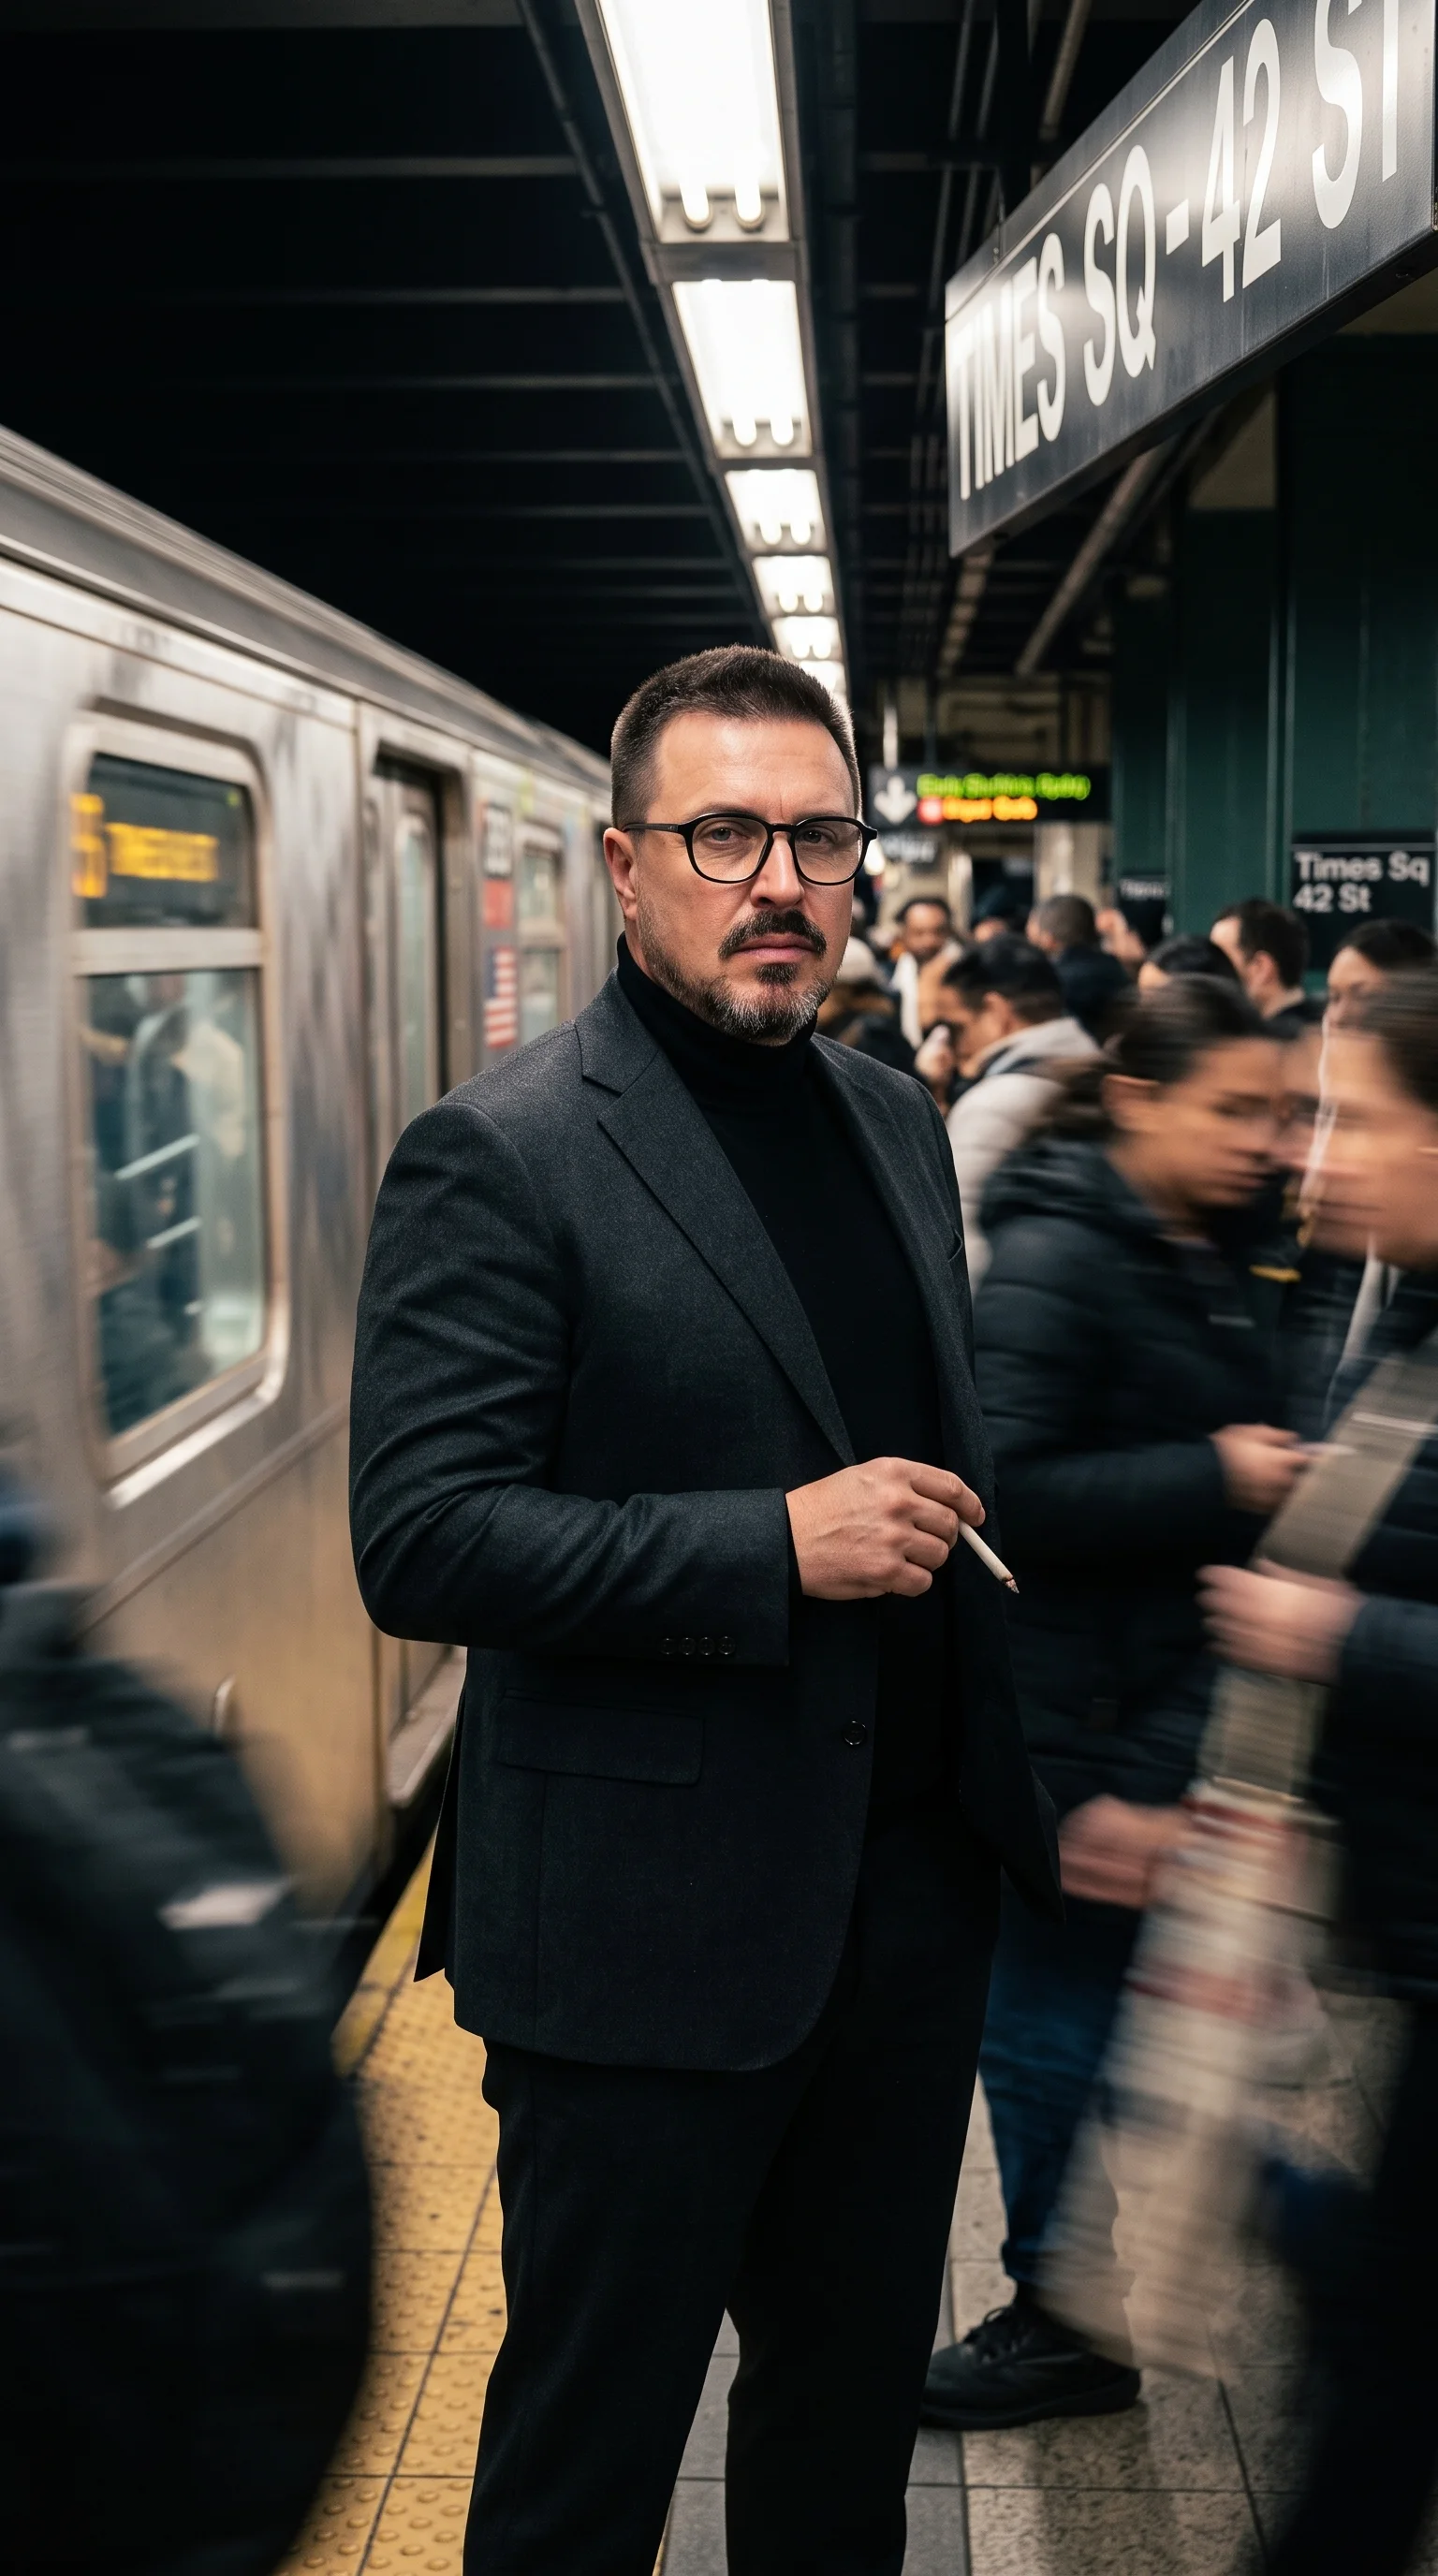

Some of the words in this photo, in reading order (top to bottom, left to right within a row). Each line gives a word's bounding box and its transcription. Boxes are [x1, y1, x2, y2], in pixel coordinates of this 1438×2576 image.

[951, 232, 1066, 501] TIMES
[1294, 851, 1383, 882] Times
[1387, 850, 1431, 887] Sq
[1293, 883, 1334, 914] 42
[1339, 883, 1372, 914] St
